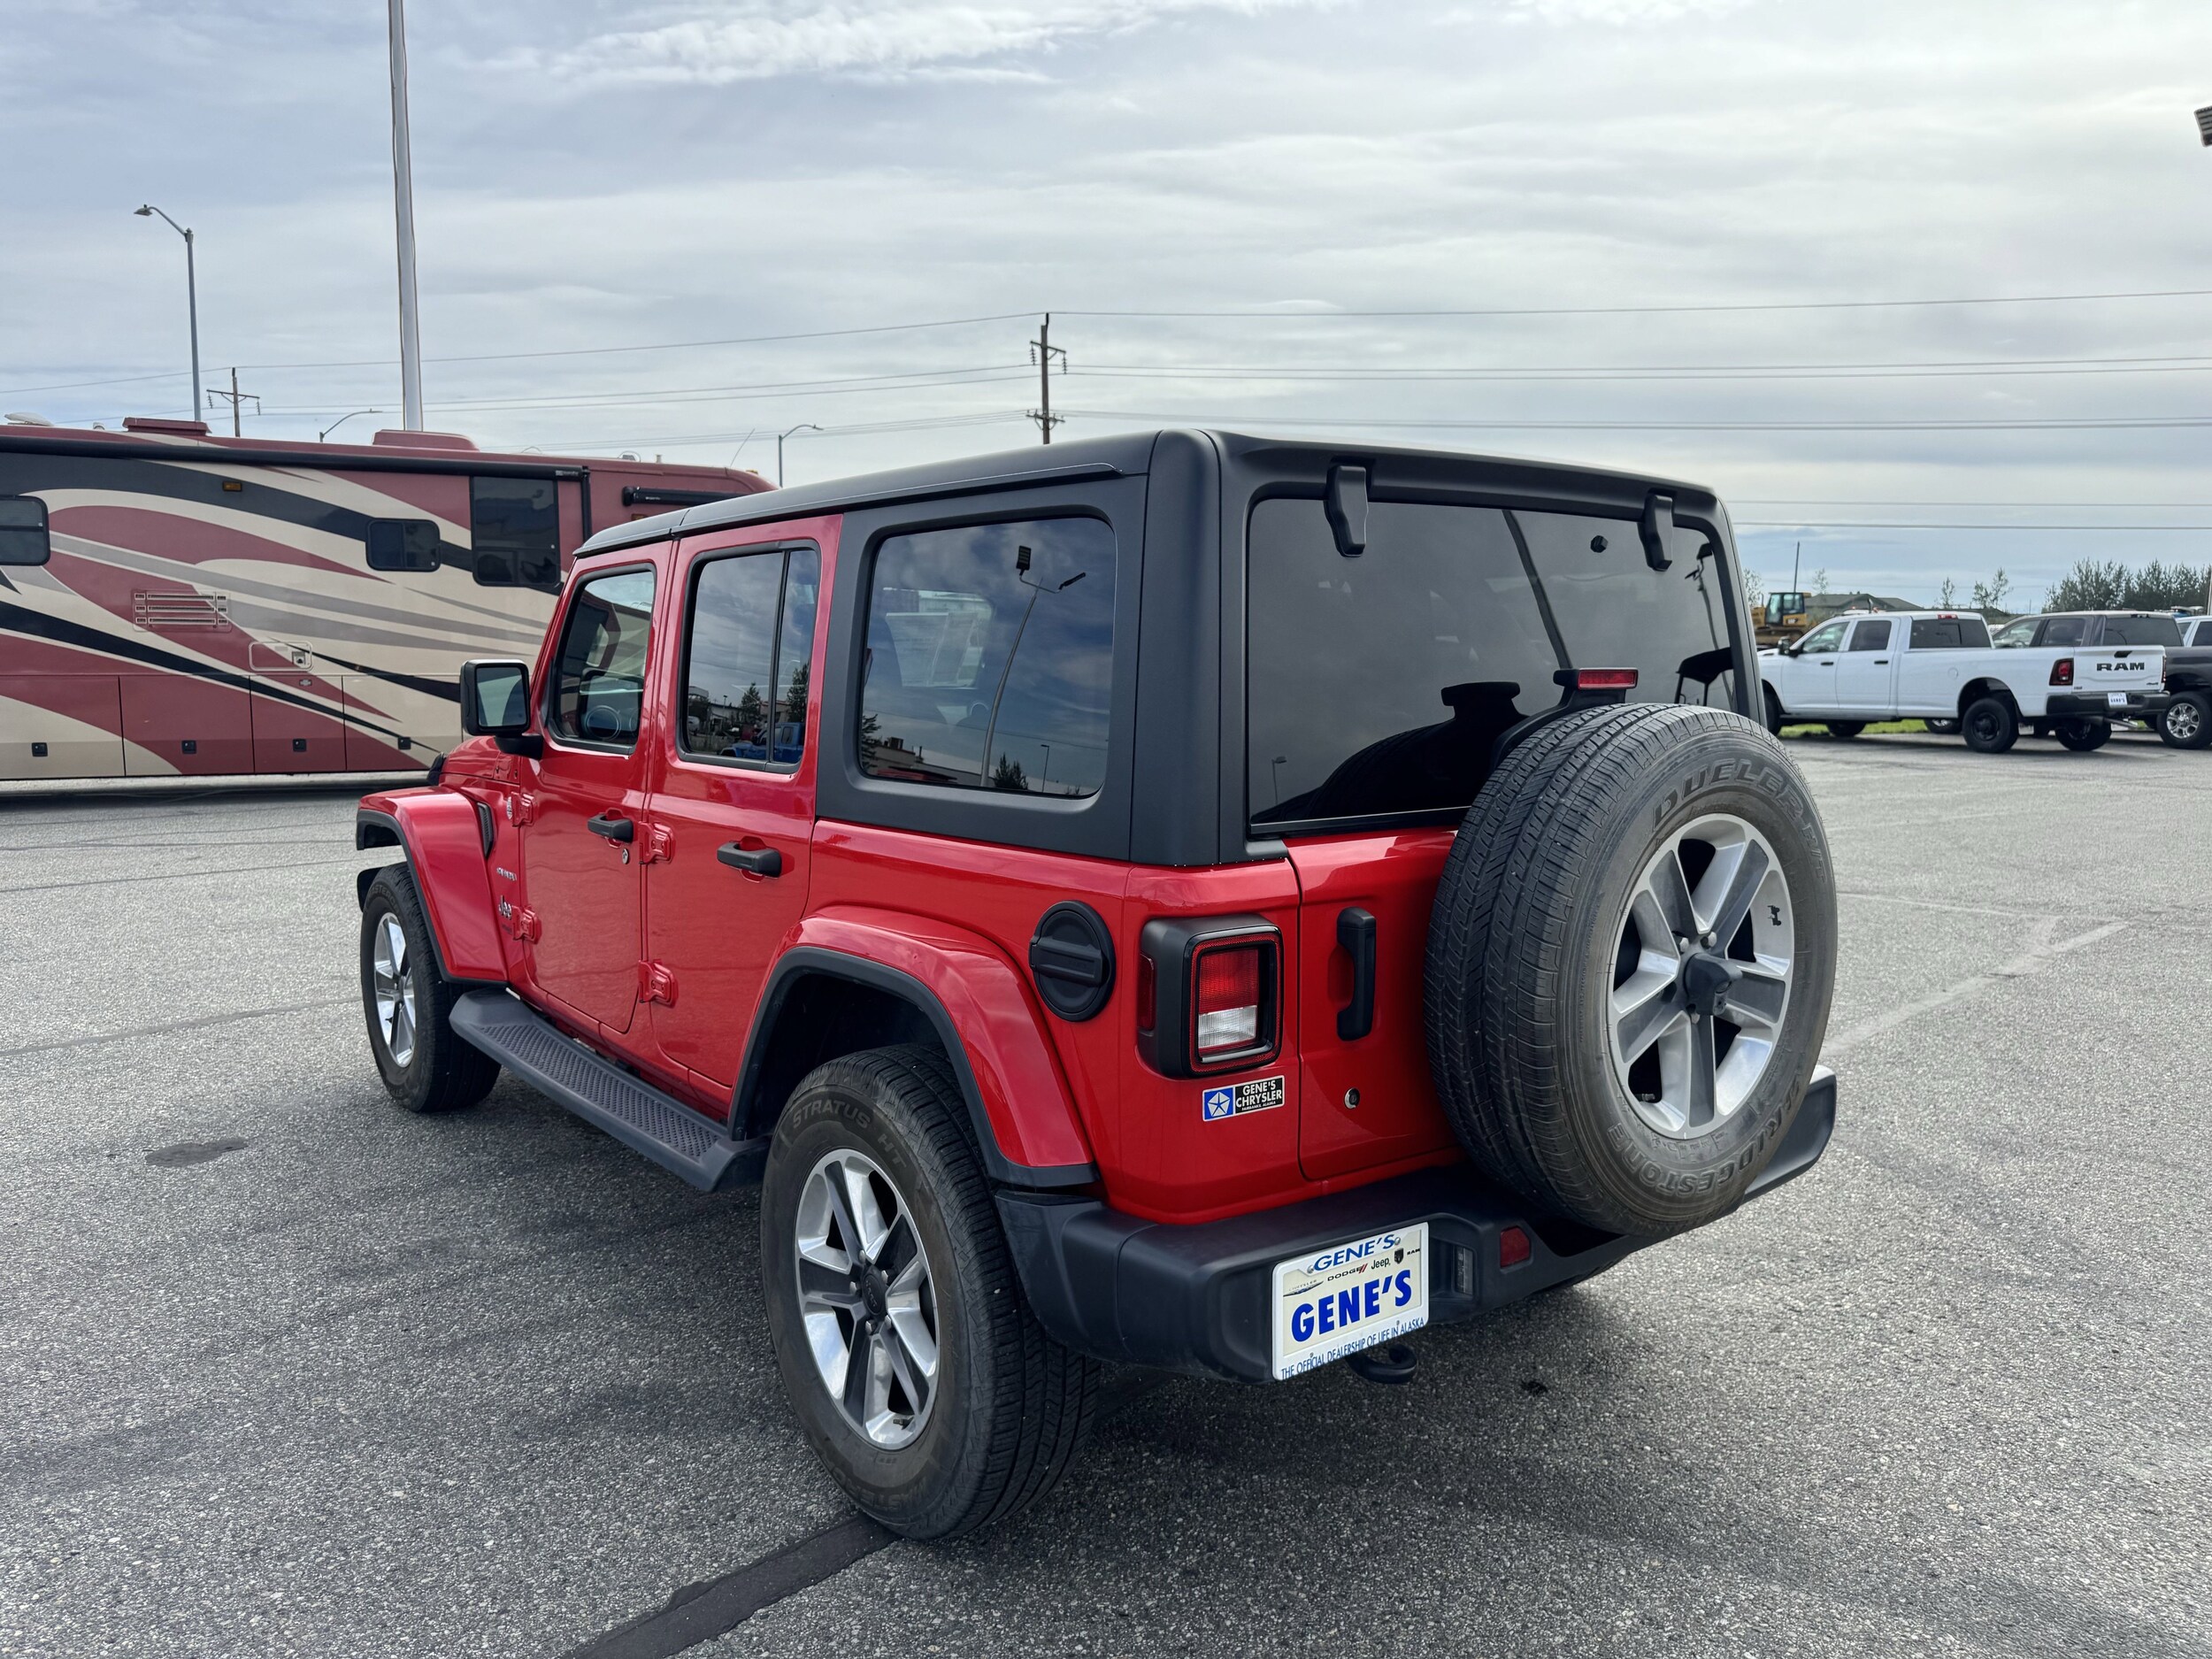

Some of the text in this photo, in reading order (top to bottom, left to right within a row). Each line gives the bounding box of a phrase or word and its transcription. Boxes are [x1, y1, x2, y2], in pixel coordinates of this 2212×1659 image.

[2096, 662, 2145, 672] RAM
[1652, 757, 1804, 833] DUELER
[1235, 1089, 1282, 1108] CHRYSLER
[1242, 1079, 1276, 1096] GENE'S
[793, 1099, 908, 1168] STRATUS HT
[1606, 1076, 1801, 1191] BRIDGESTONE
[1314, 1234, 1395, 1271] GENE'S
[1327, 1266, 1363, 1282] DODGE
[1292, 1269, 1412, 1342] GENE'S
[1281, 1317, 1425, 1380] THE OFFICIAL DEALERSHIP OF LIFE IN ALASKA
